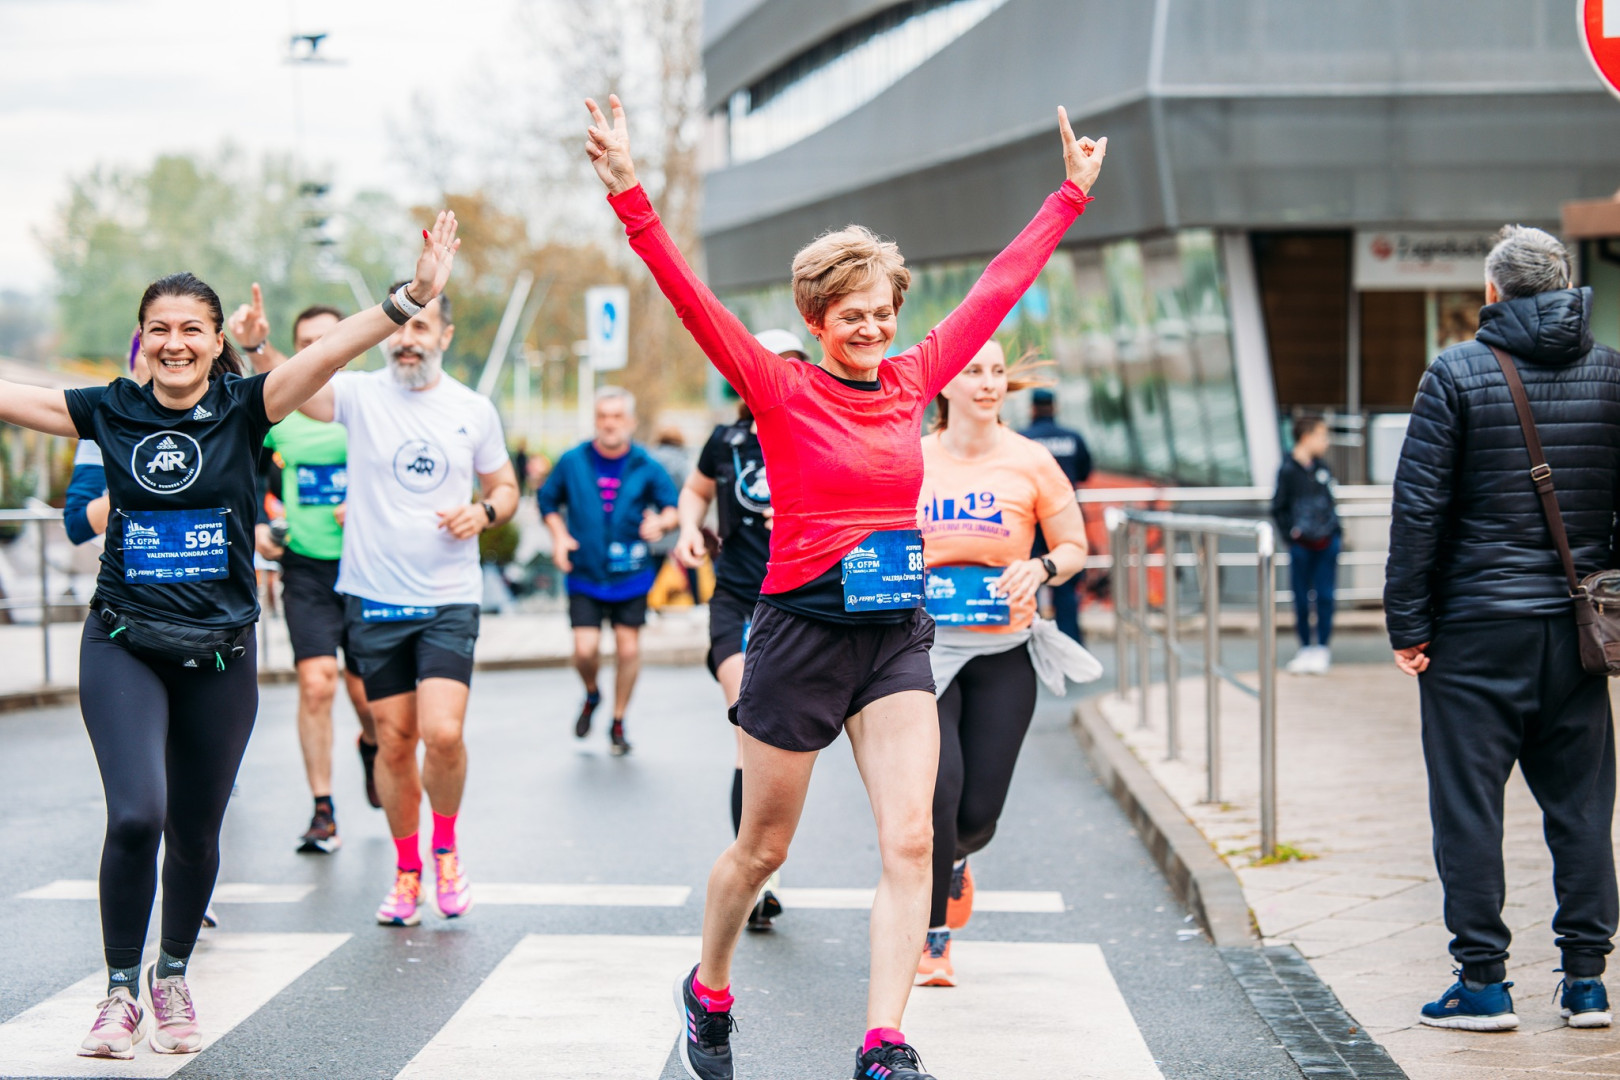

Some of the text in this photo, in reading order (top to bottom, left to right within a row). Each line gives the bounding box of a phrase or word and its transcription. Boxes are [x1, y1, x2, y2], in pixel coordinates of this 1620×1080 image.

[185, 529, 225, 549] 594
[843, 560, 880, 570] 19. OFPM
